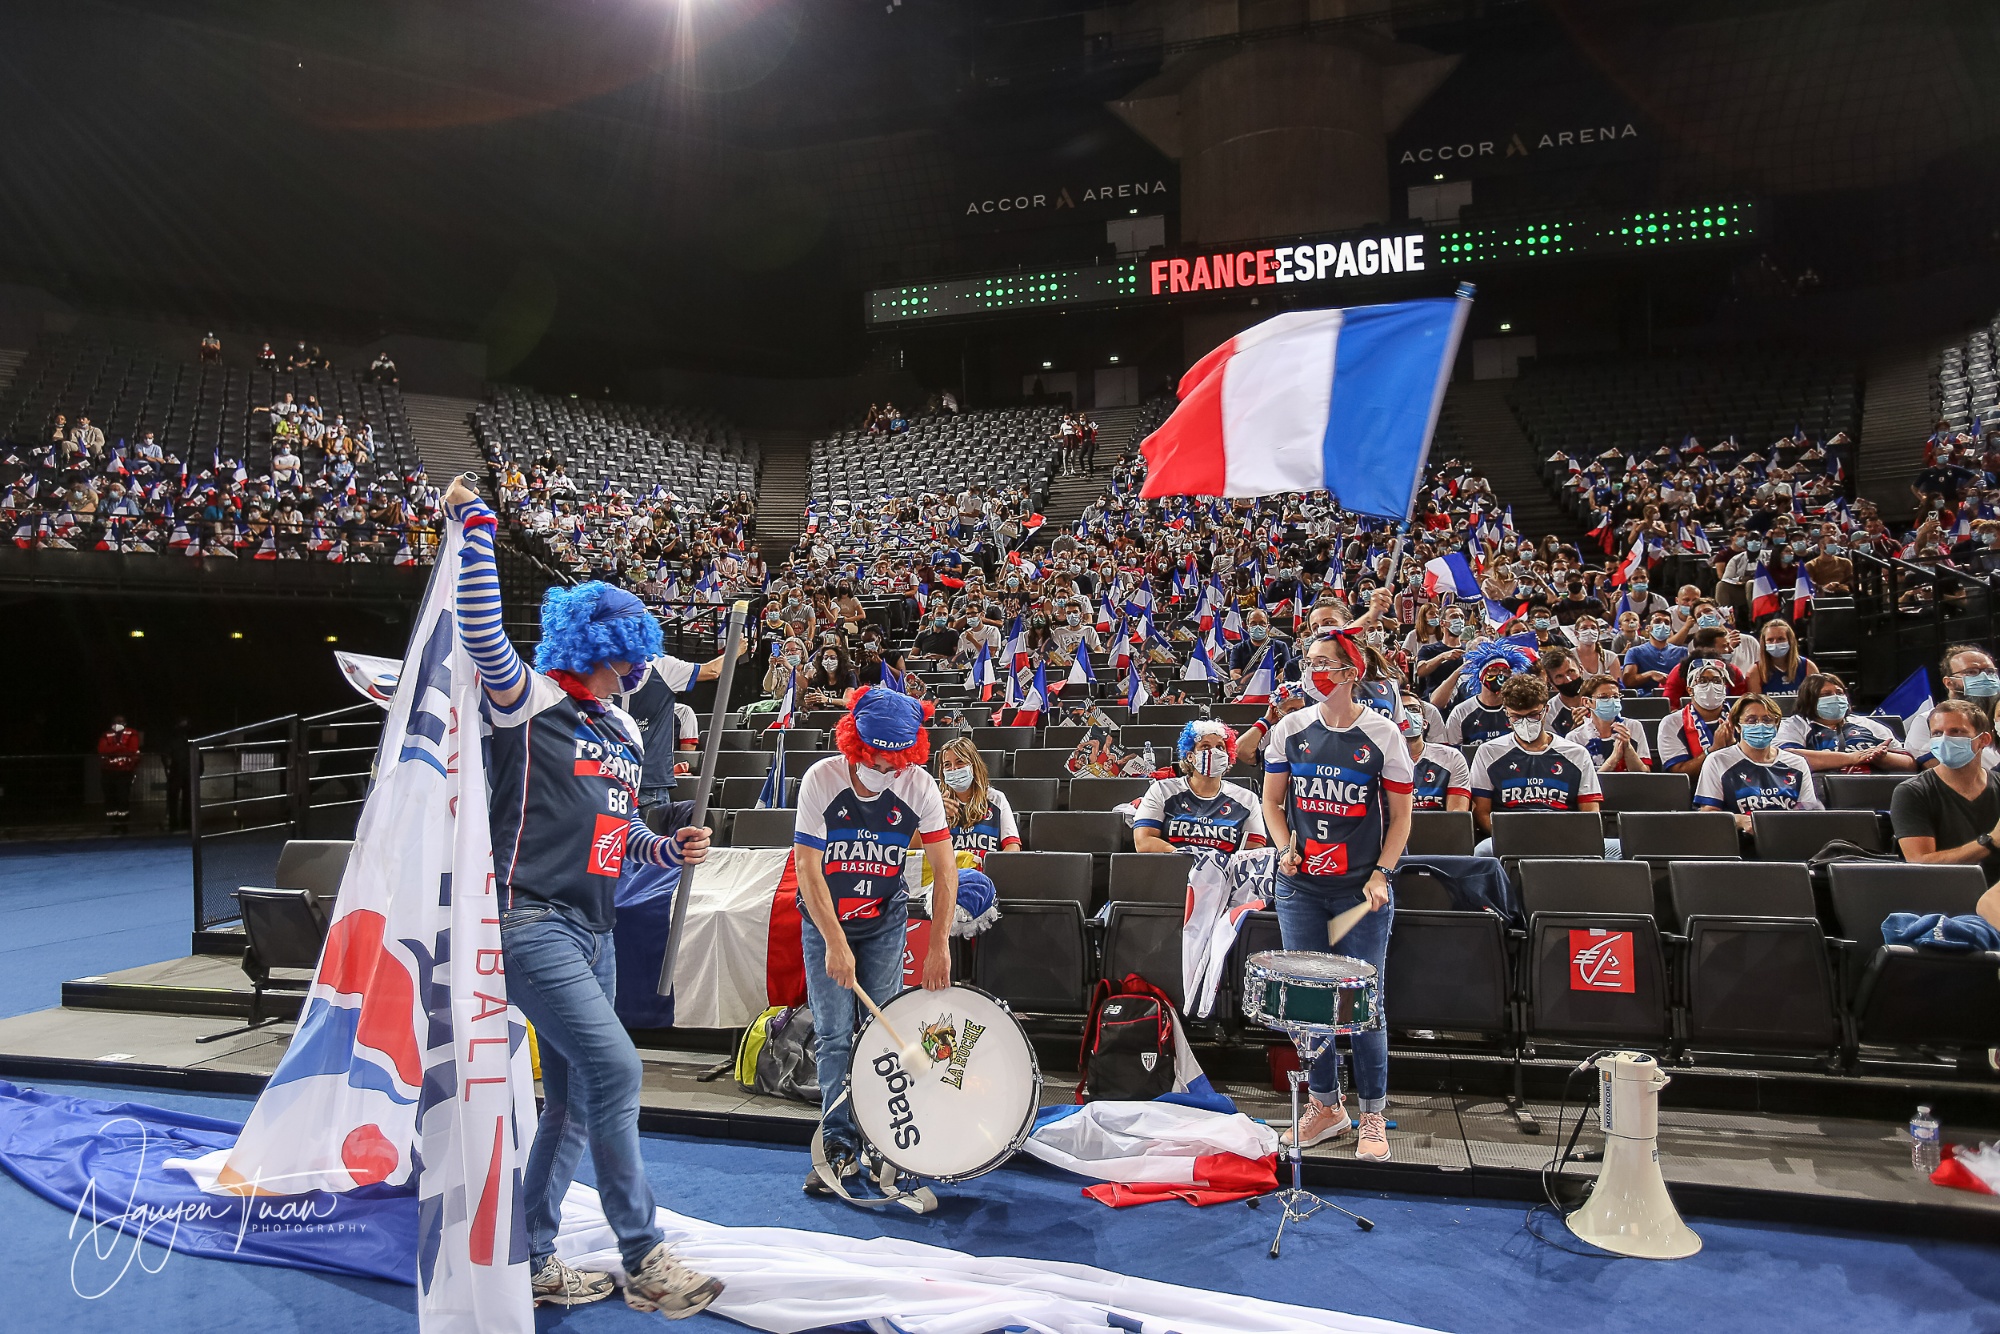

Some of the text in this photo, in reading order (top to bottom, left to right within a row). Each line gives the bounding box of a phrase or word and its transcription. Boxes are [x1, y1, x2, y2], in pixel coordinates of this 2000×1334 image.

[1400, 123, 1638, 164] ACCOR ARENA
[966, 180, 1167, 215] ACCOR ARENA
[1150, 249, 1276, 296] FRANCE
[1275, 234, 1426, 284] ESPAGNE
[574, 739, 643, 798] FRANC
[1315, 765, 1341, 778] KOP
[1527, 778, 1544, 786] KOP
[1760, 787, 1780, 796] KOP
[608, 787, 629, 815] 68
[1501, 786, 1569, 805] FRANCE
[1736, 795, 1797, 814] FRANC
[1301, 800, 1349, 816] BASKET
[857, 828, 879, 841] KOP
[1168, 820, 1238, 844] FRANCE
[1316, 819, 1329, 840] 5
[840, 862, 888, 875] BASKET
[853, 879, 872, 897] 41
[953, 1018, 987, 1068] RUCHE
[872, 1051, 921, 1150] Stagg
